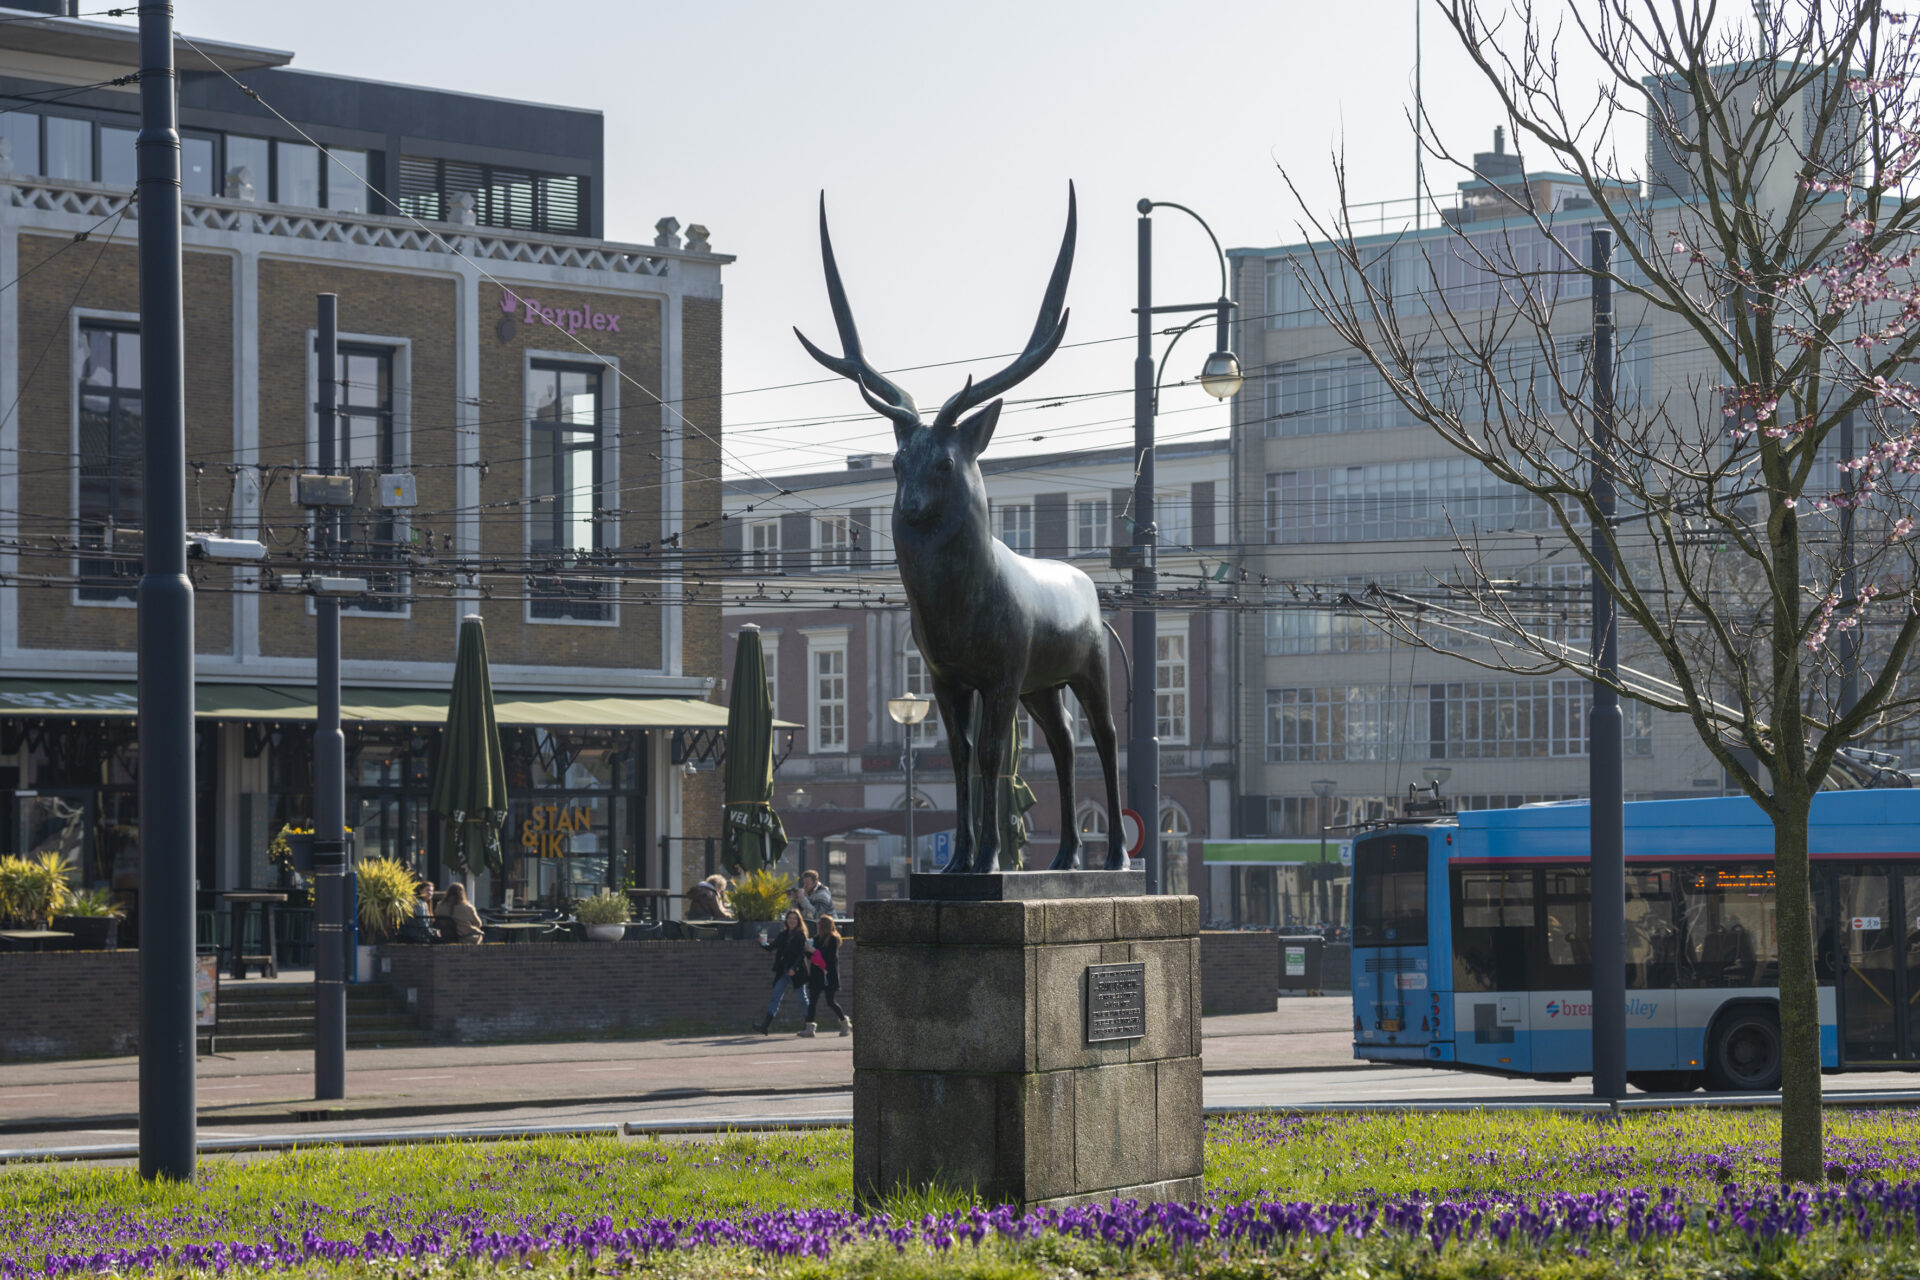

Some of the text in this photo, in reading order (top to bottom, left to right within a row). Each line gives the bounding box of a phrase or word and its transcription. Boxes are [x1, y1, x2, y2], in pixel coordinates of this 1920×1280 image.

[523, 297, 621, 335] Perplex
[532, 805, 592, 831] STAN
[521, 819, 539, 847] &
[541, 833, 564, 859] IK
[938, 834, 946, 852] P
